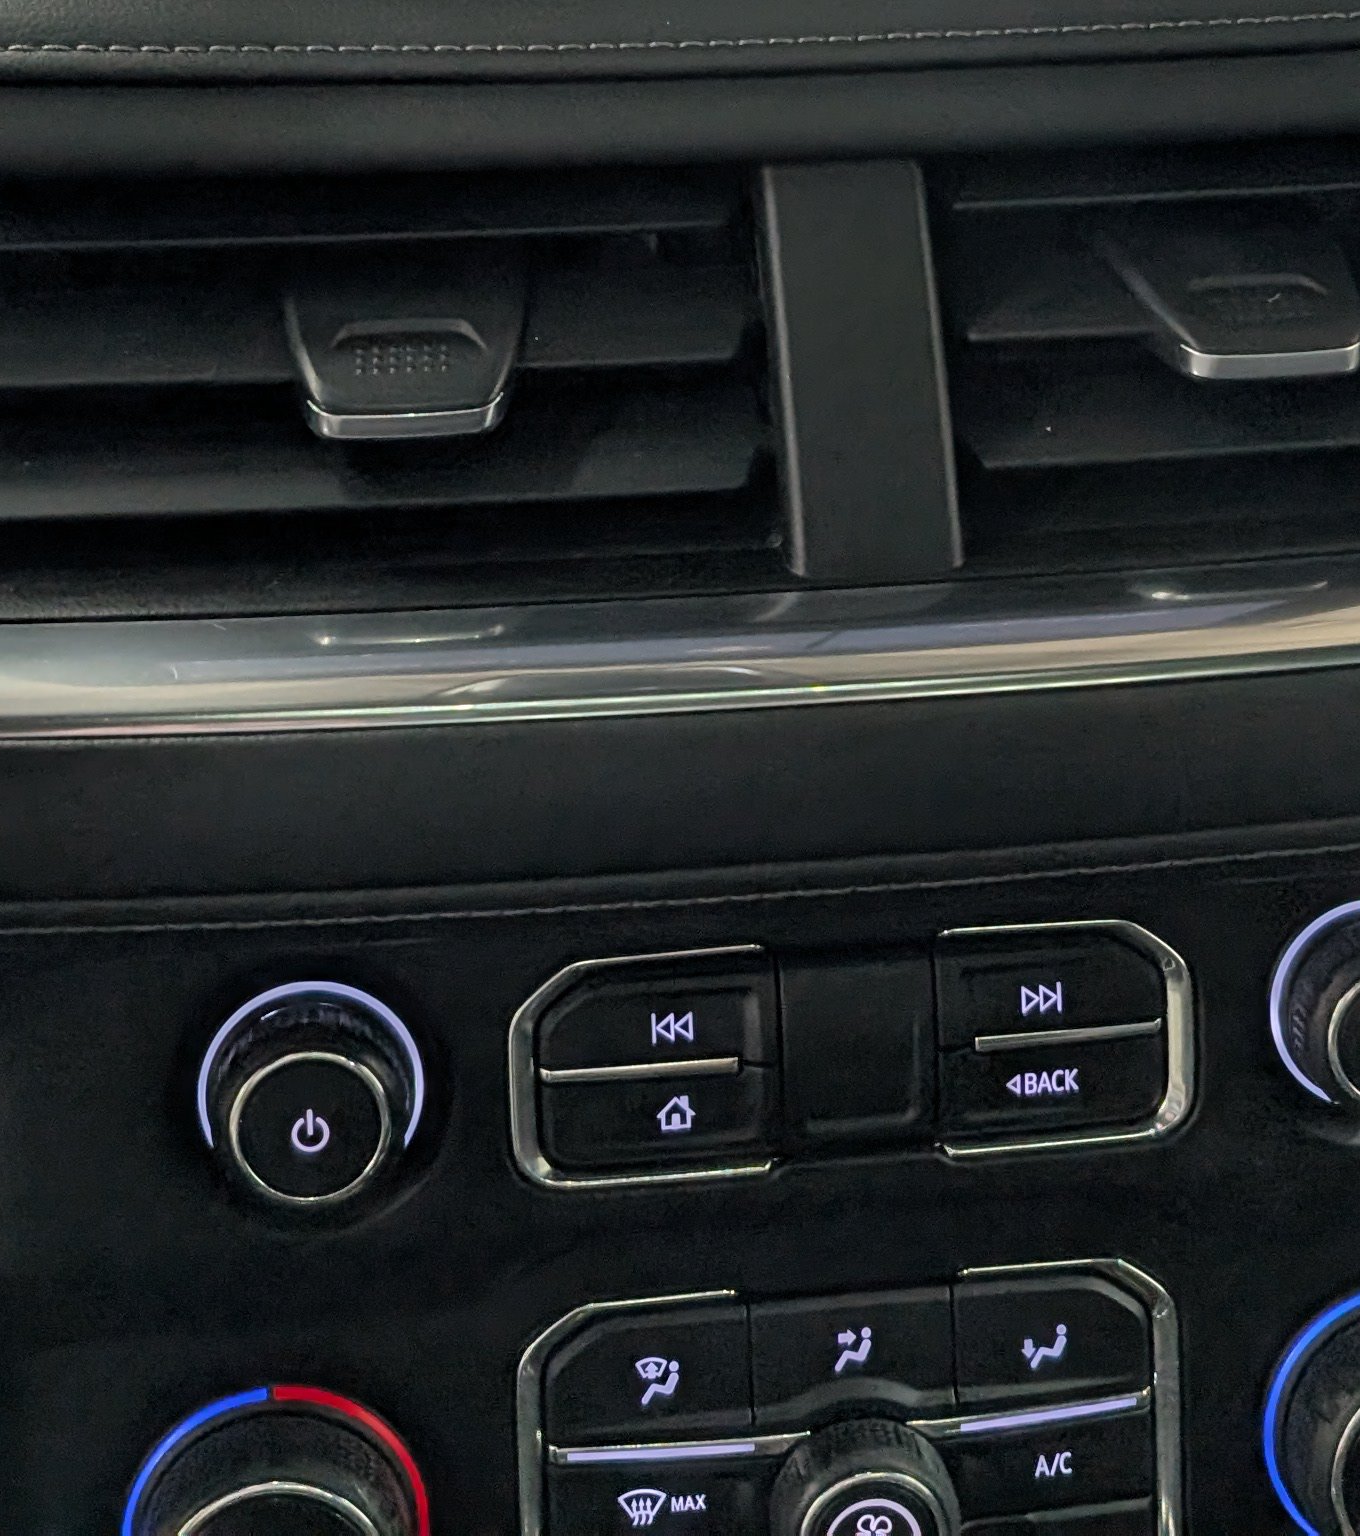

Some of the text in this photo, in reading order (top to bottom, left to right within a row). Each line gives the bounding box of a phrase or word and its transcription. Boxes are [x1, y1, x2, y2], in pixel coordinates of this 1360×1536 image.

[1025, 1069, 1078, 1094] BACK
[1035, 1452, 1072, 1477] A/C
[671, 1494, 706, 1512] MAX
